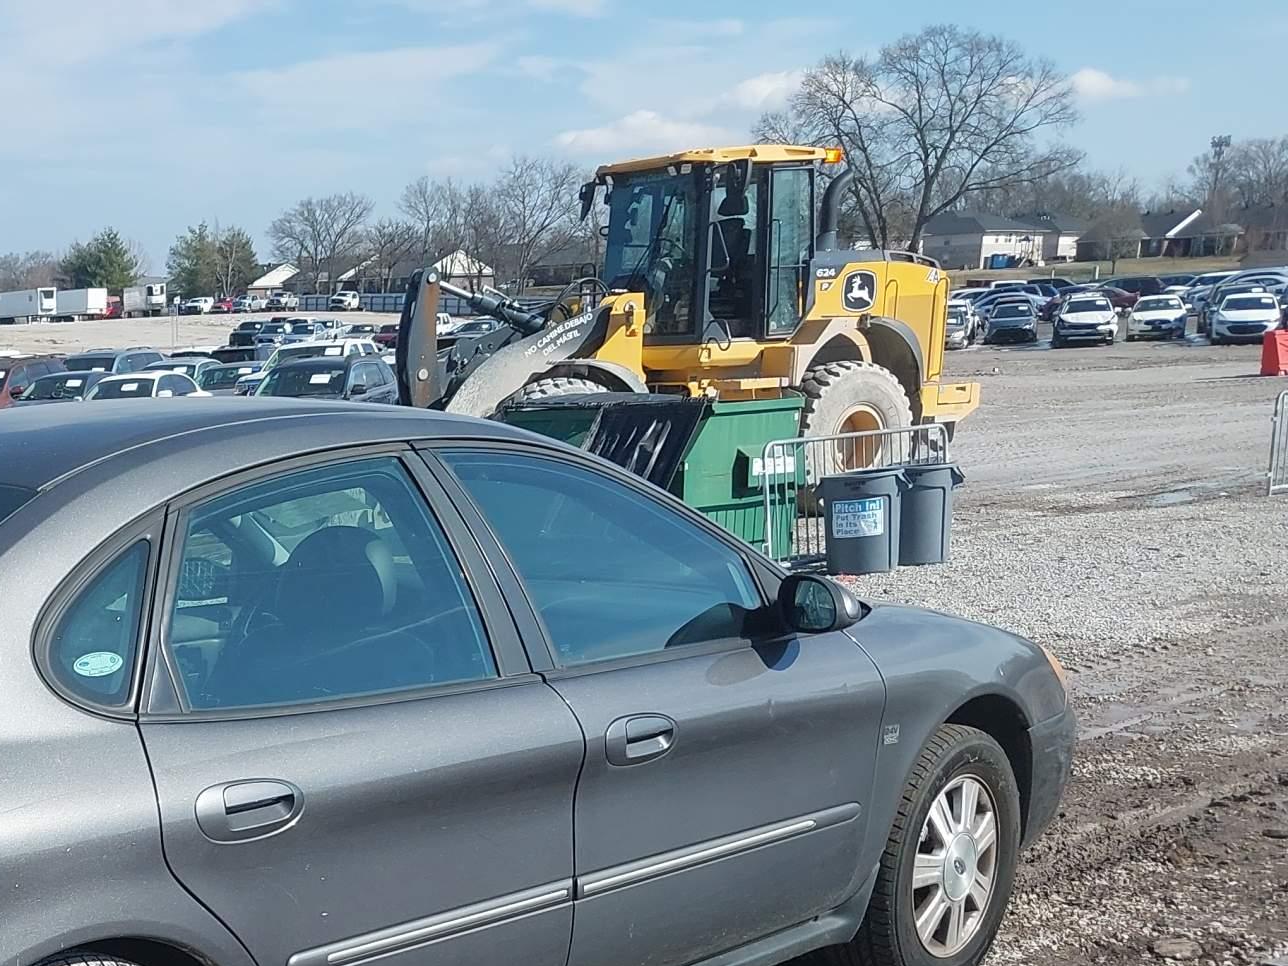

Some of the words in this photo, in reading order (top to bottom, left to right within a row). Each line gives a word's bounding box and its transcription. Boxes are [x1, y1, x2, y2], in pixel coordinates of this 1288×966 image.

[816, 268, 836, 277] 624
[525, 345, 537, 358] NO
[537, 325, 565, 348] CAMINE
[564, 313, 593, 330] DEBAJO
[543, 343, 557, 356] DEL
[835, 503, 862, 513] Pitch
[866, 500, 880, 510] In!
[851, 512, 877, 520] Trash
